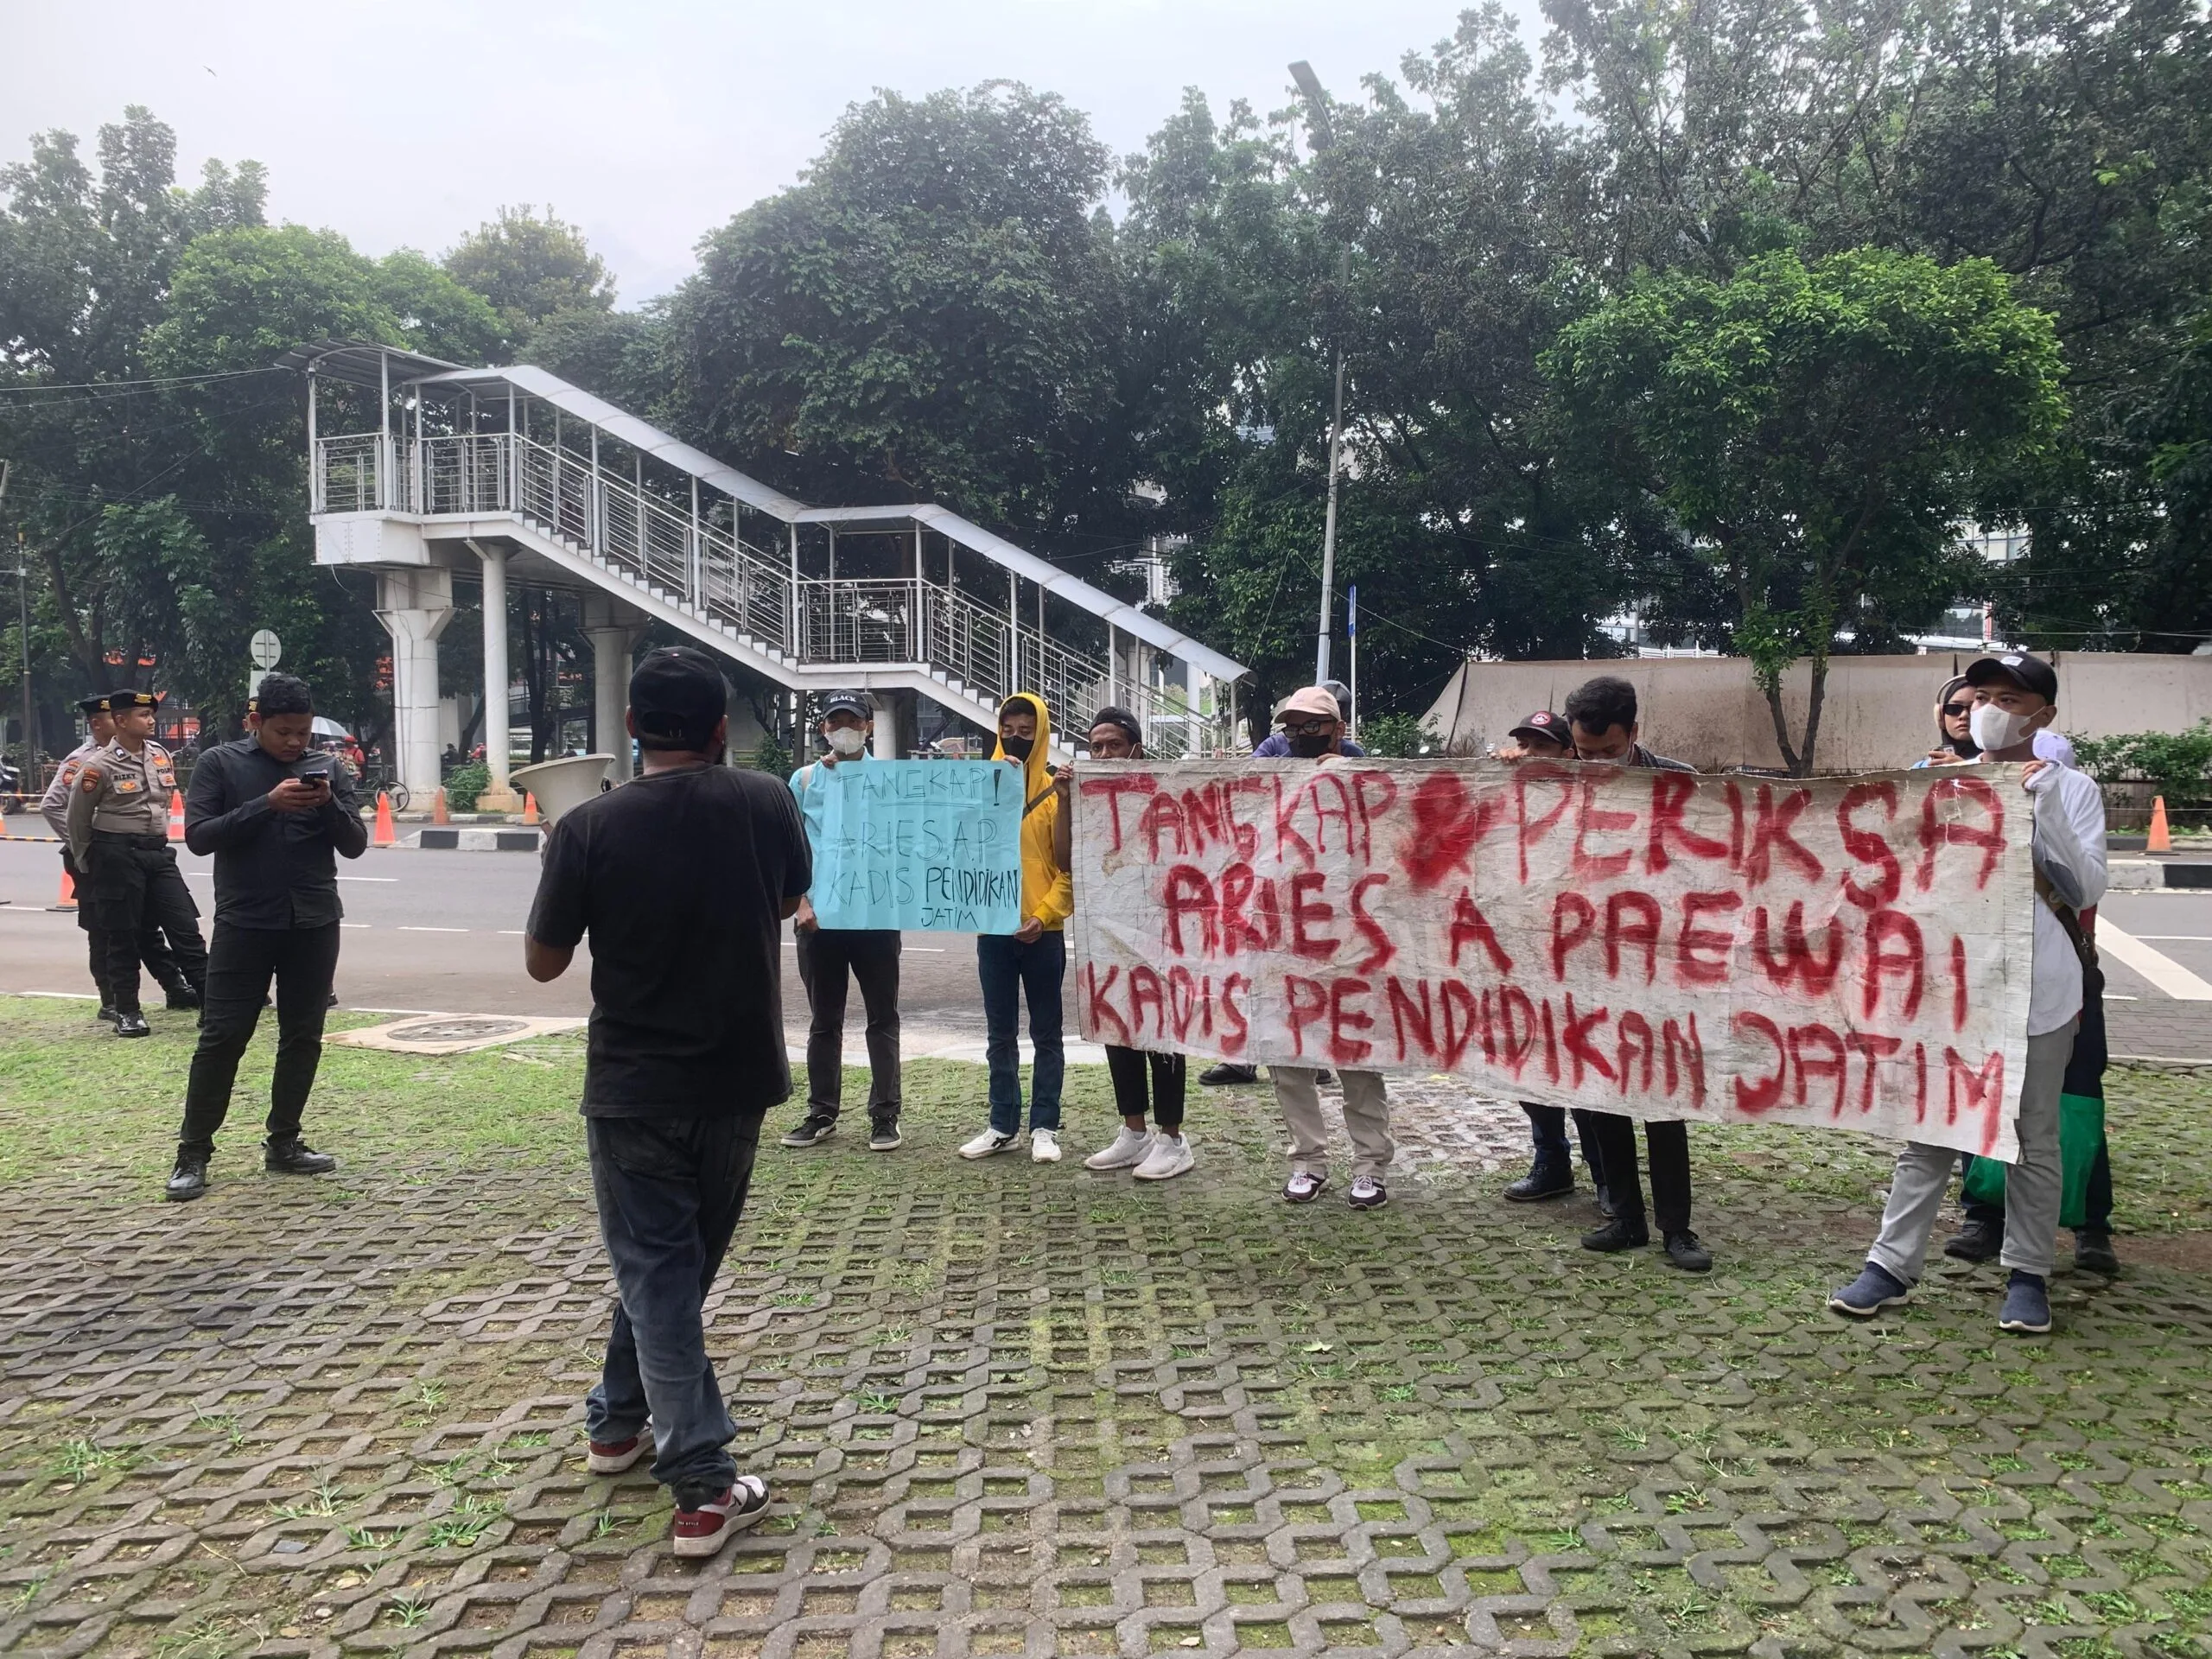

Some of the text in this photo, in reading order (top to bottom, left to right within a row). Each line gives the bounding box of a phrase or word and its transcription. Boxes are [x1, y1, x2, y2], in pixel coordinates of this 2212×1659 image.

[830, 695, 856, 703] BLACK
[1080, 769, 1397, 868] TANGKAP
[1512, 760, 2009, 909] PERIKSA
[825, 868, 914, 908] KADIS
[921, 907, 979, 929] JATIM
[1163, 862, 1968, 1033] ARIES A PAEWAI
[1086, 961, 2005, 1157] KADIS PENDIDIKAN JATIM
